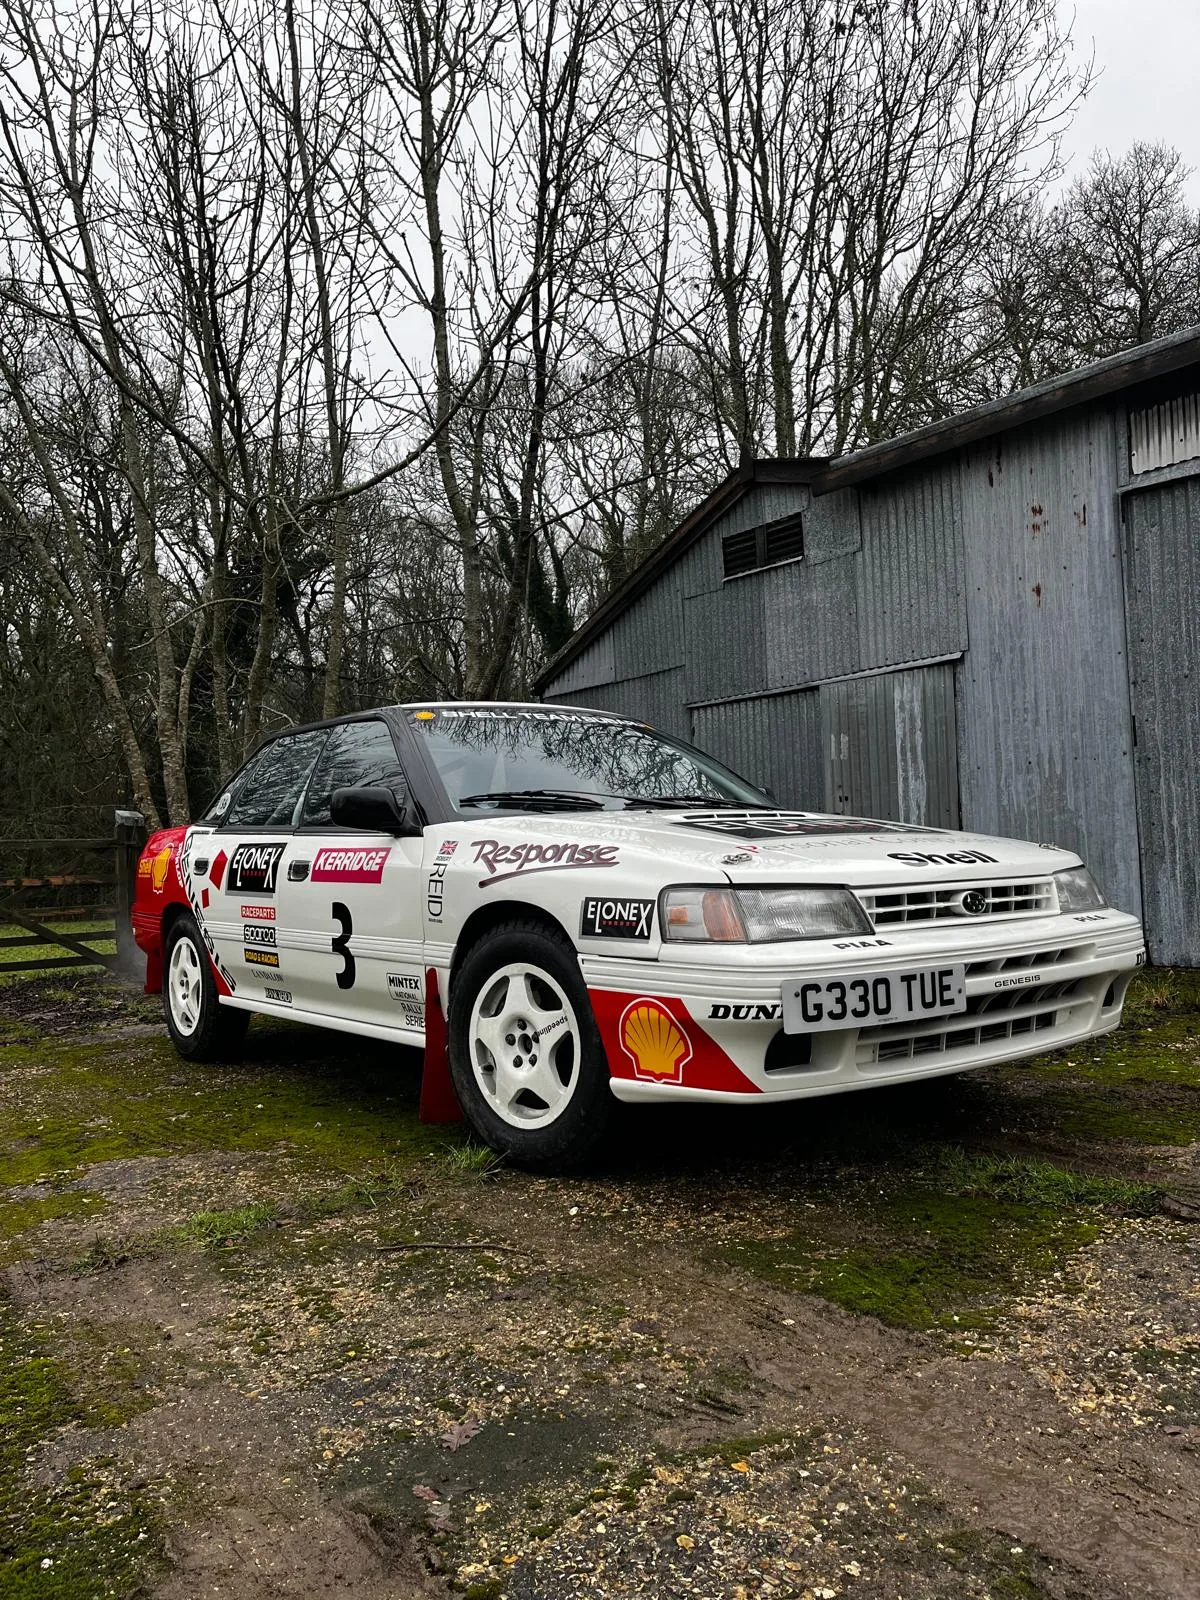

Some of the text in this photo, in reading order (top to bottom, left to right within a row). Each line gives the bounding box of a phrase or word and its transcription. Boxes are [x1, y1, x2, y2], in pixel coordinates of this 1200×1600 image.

[442, 710, 518, 719] SHELL
[518, 712, 582, 722] TEAM
[314, 851, 388, 871] KERRIDGE
[470, 839, 620, 874] Response
[886, 850, 1000, 867] Shell
[232, 847, 282, 888] ELONEX
[427, 862, 449, 917] REID
[241, 906, 275, 919] RACEPARTS
[587, 901, 652, 936] ELONEX
[244, 926, 275, 942] sparco
[331, 901, 356, 990] 3
[832, 939, 893, 950] PIAA
[388, 975, 420, 990] MINTEX
[994, 974, 1041, 988] GENESIS
[800, 969, 955, 1023] G330 TUE
[400, 1002, 423, 1015] RALLY
[708, 1004, 783, 1020] DUN
[405, 1014, 425, 1028] SERIE
